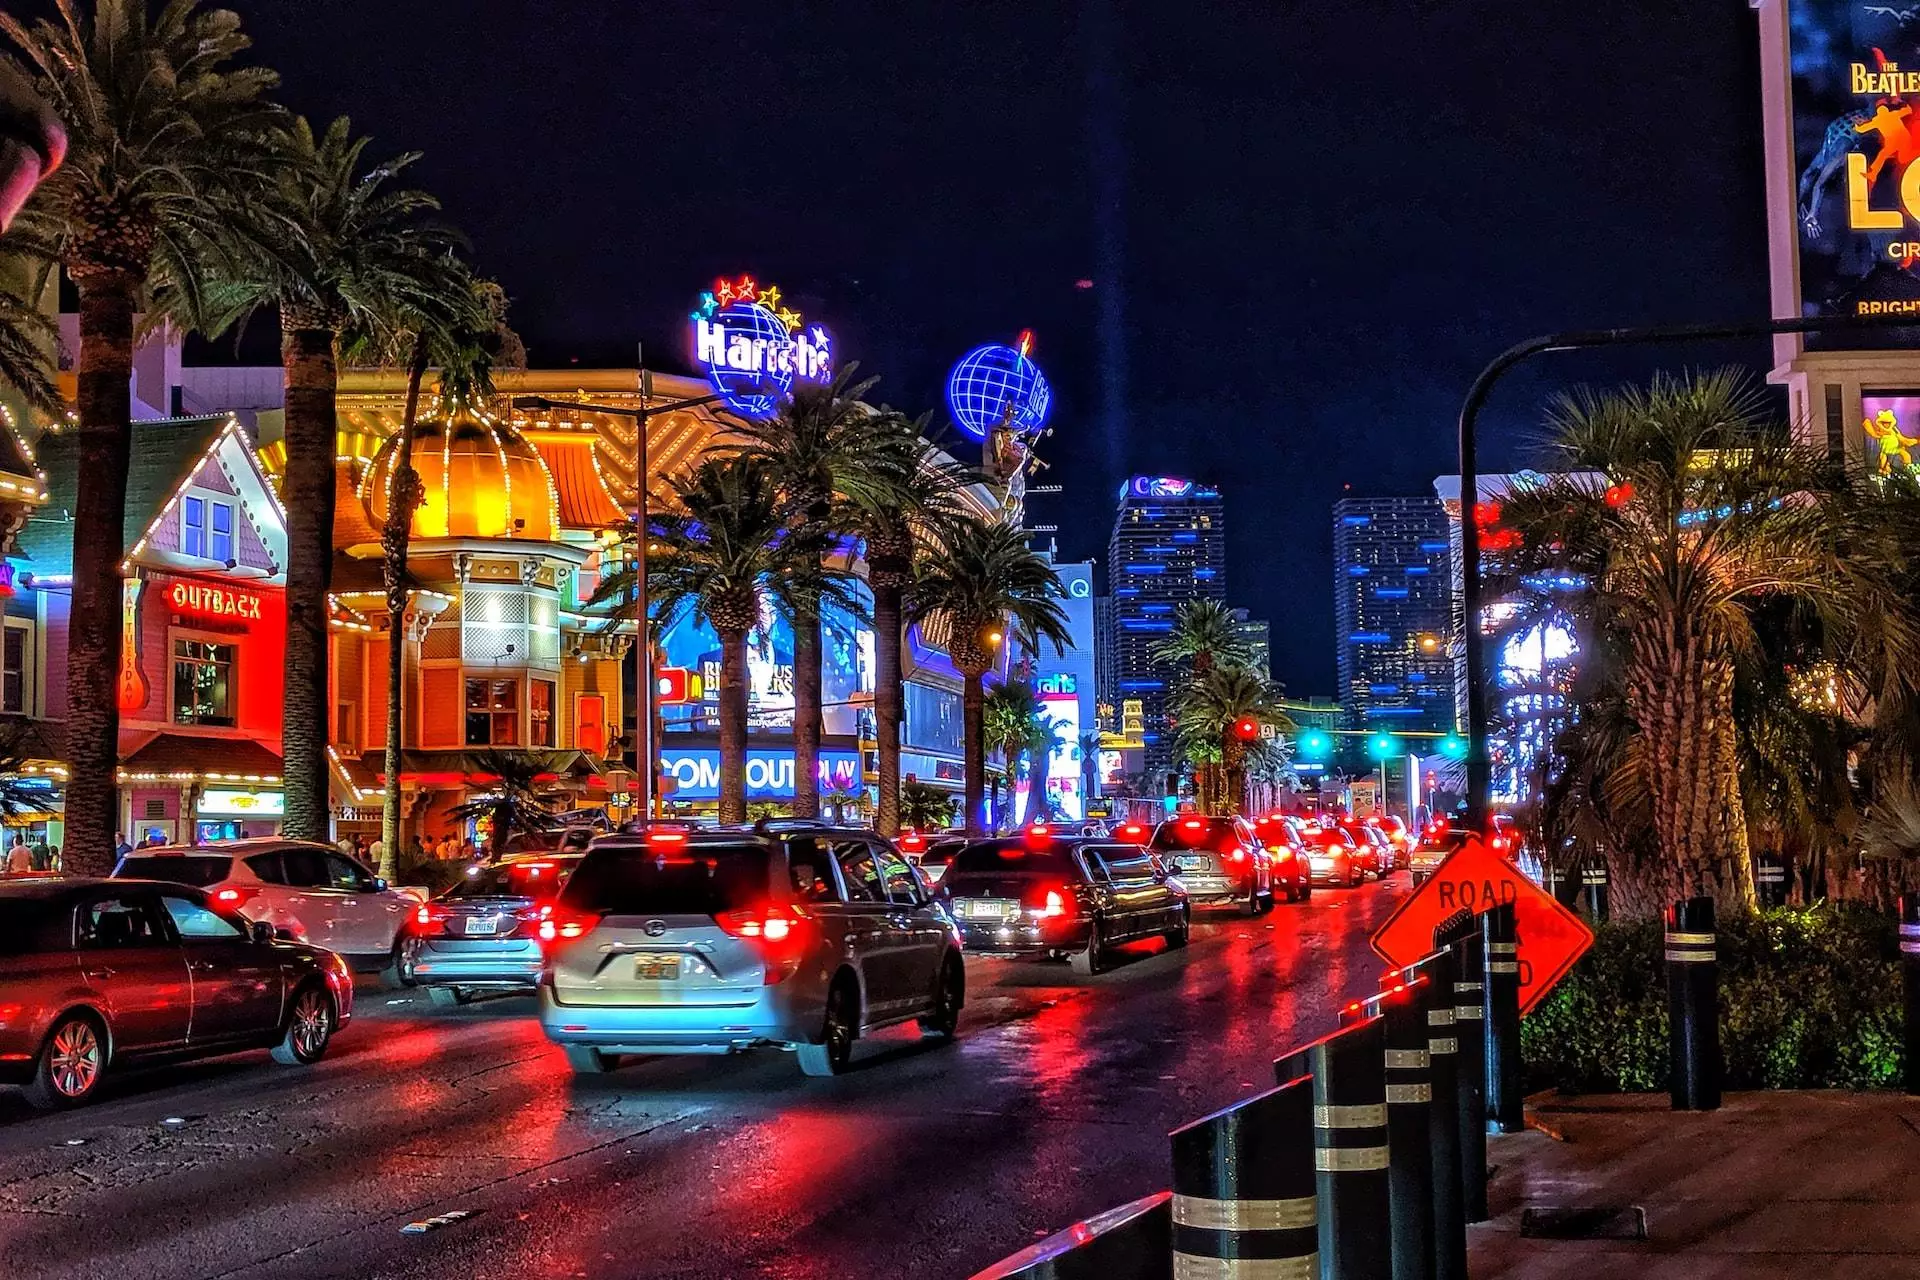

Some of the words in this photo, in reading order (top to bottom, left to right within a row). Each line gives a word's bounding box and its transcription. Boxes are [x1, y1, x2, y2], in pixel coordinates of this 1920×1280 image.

[1851, 62, 1920, 97] BEATLE
[1882, 62, 1899, 72] THE
[125, 582, 133, 617] FAT
[172, 583, 262, 619] OUTBACK
[125, 622, 133, 705] TUESDAY
[1438, 880, 1517, 909] ROAD
